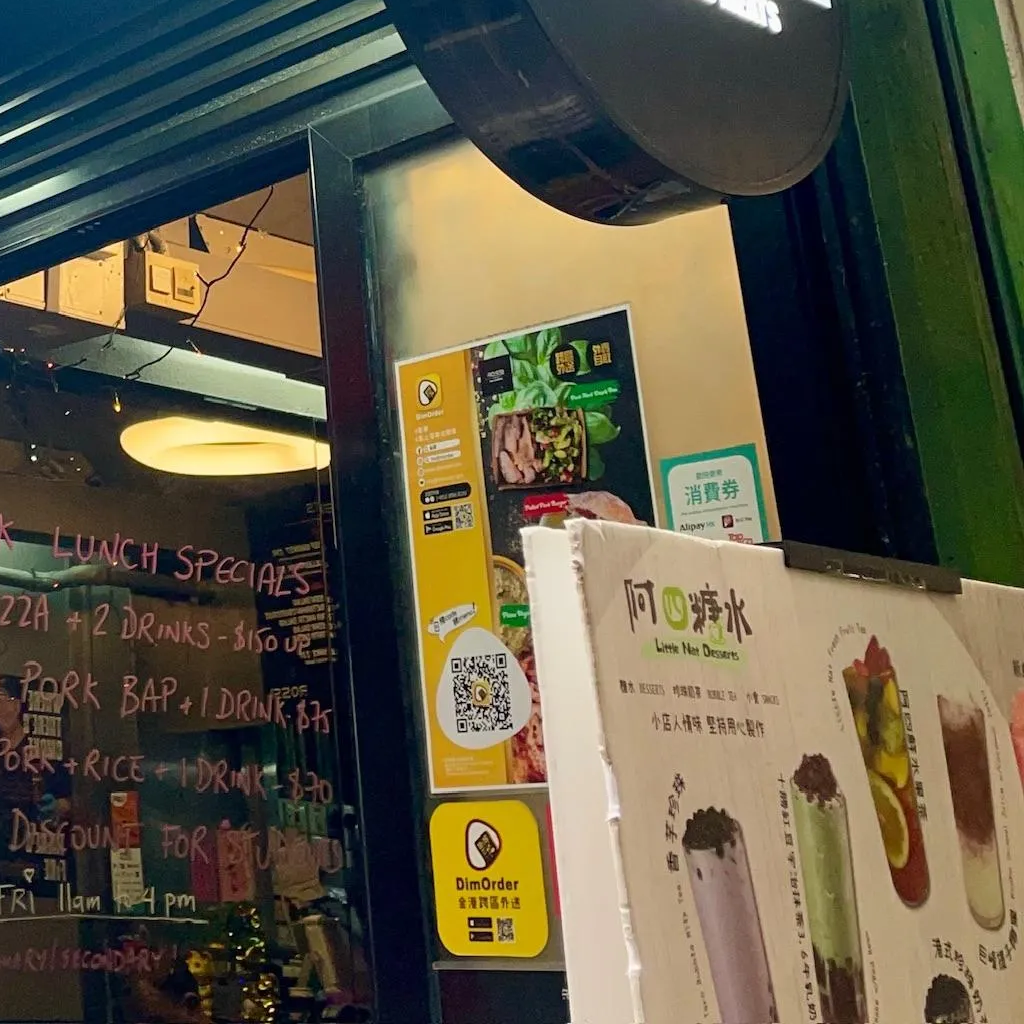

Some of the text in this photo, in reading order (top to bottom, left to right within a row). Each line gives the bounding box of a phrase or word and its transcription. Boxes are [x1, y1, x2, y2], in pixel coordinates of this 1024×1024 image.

[684, 479, 739, 506] 消費券
[680, 522, 706, 532] Alipay
[52, 526, 159, 576] LUNCH
[175, 545, 311, 597] SPECIALS
[92, 603, 110, 636] 2
[121, 606, 210, 650] DRINKS
[654, 637, 679, 654] Little
[702, 642, 740, 661] Desserts
[20, 659, 101, 710] PORK
[120, 675, 177, 718] BAP
[83, 749, 145, 783] RICE
[160, 824, 210, 865] FOR
[456, 877, 519, 891] DimOrder
[165, 891, 196, 918] pm
